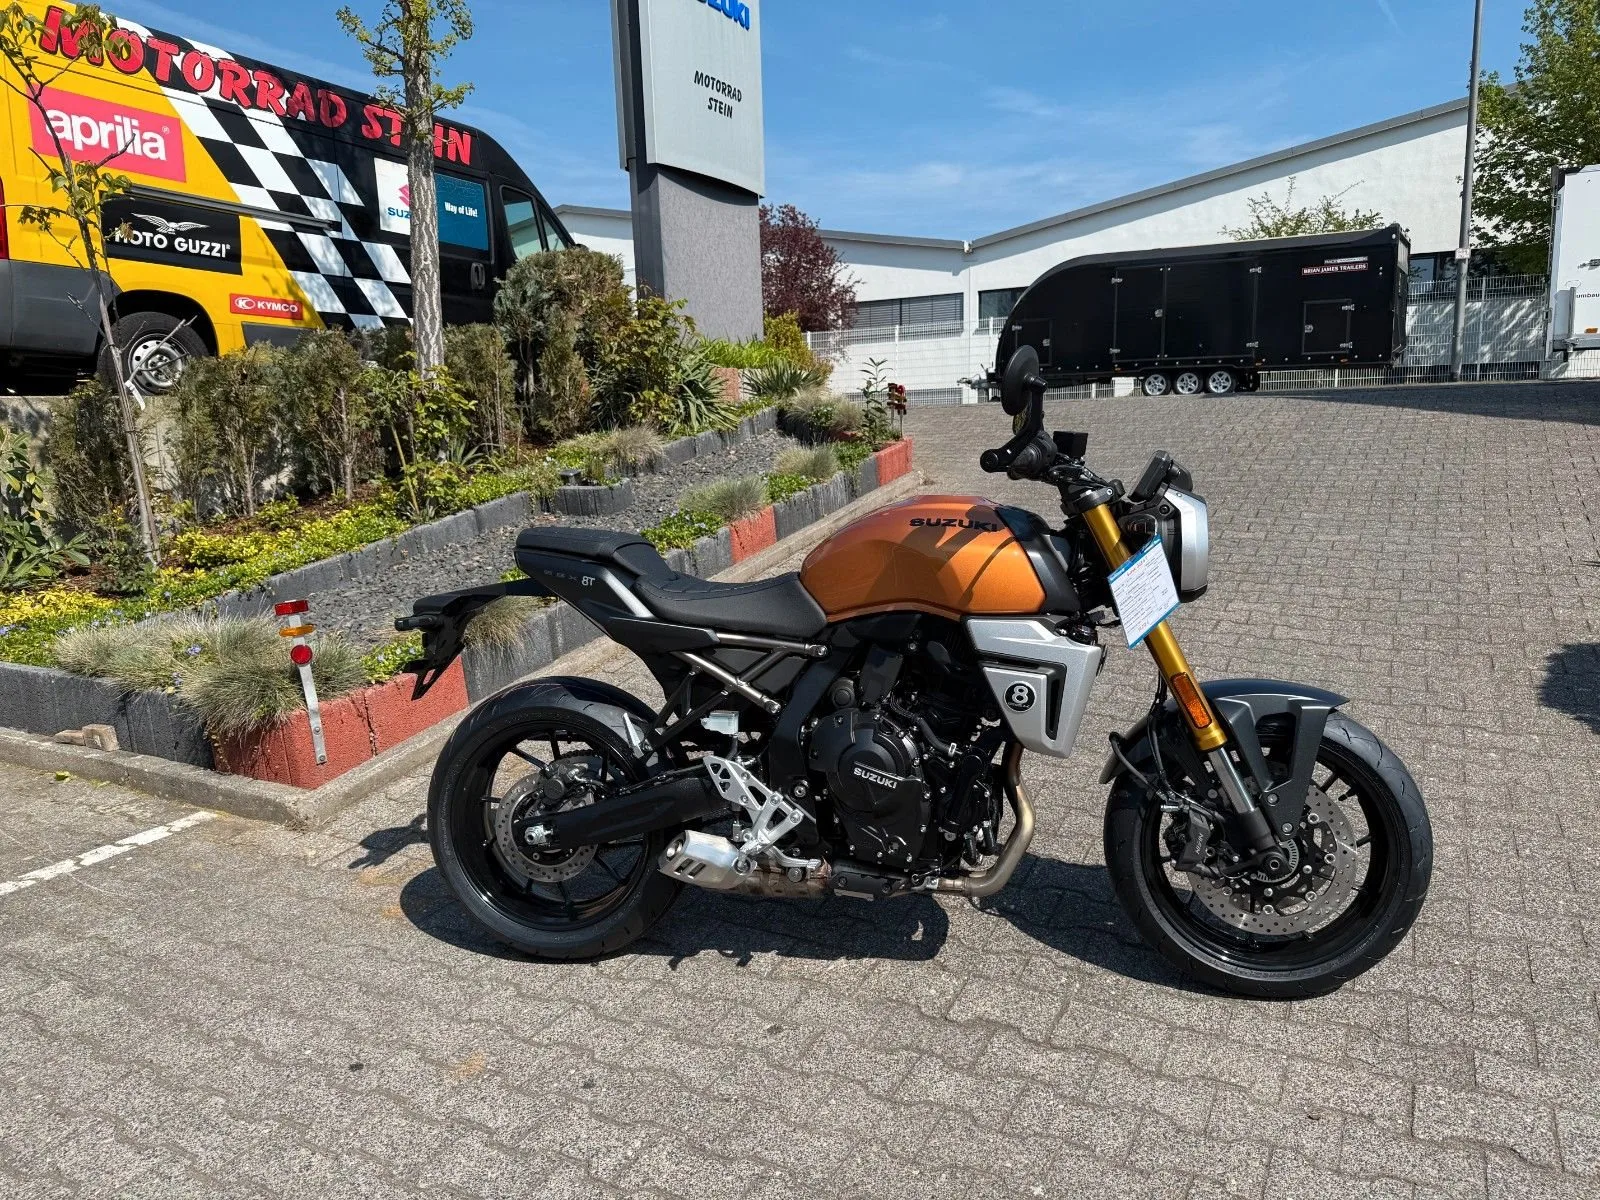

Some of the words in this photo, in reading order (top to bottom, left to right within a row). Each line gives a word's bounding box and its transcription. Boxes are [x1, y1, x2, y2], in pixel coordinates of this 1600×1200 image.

[39, 5, 347, 128] MOTORRAD
[361, 103, 472, 166] STIN
[693, 70, 742, 103] MOTORRAD
[707, 97, 733, 119] STEIN
[45, 109, 167, 161] aprilia
[388, 207, 412, 219] SUZ
[444, 201, 458, 215] Way
[458, 205, 465, 214] of
[465, 206, 478, 218] Life!
[114, 227, 168, 249] MOTO
[174, 237, 226, 258] GUZZI
[1303, 267, 1320, 275] BRIAN
[1320, 265, 1339, 273] JAMES
[1340, 263, 1366, 271] TRAILERS
[257, 301, 298, 313] KYMCO
[909, 517, 998, 533] SUZUKI
[581, 575, 596, 587] 8T
[1011, 684, 1029, 704] 8
[853, 767, 898, 789] SUZUKI
